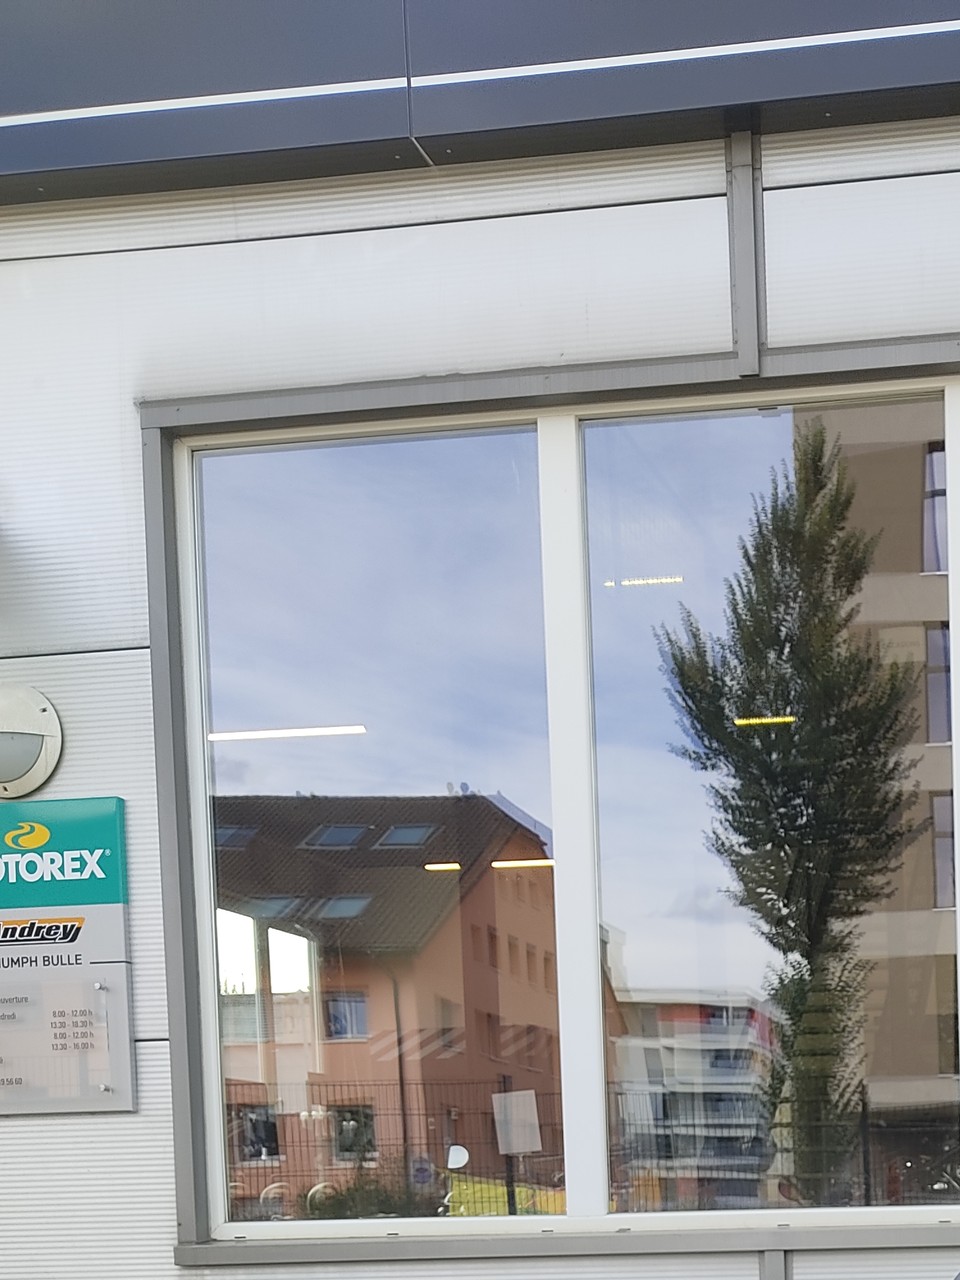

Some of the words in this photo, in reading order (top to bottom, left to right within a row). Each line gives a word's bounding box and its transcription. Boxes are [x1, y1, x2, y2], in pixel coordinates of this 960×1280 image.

[0, 849, 107, 883] TOREX
[0, 920, 77, 942] ndrey
[0, 955, 38, 969] UMPH
[42, 954, 82, 967] BULLE
